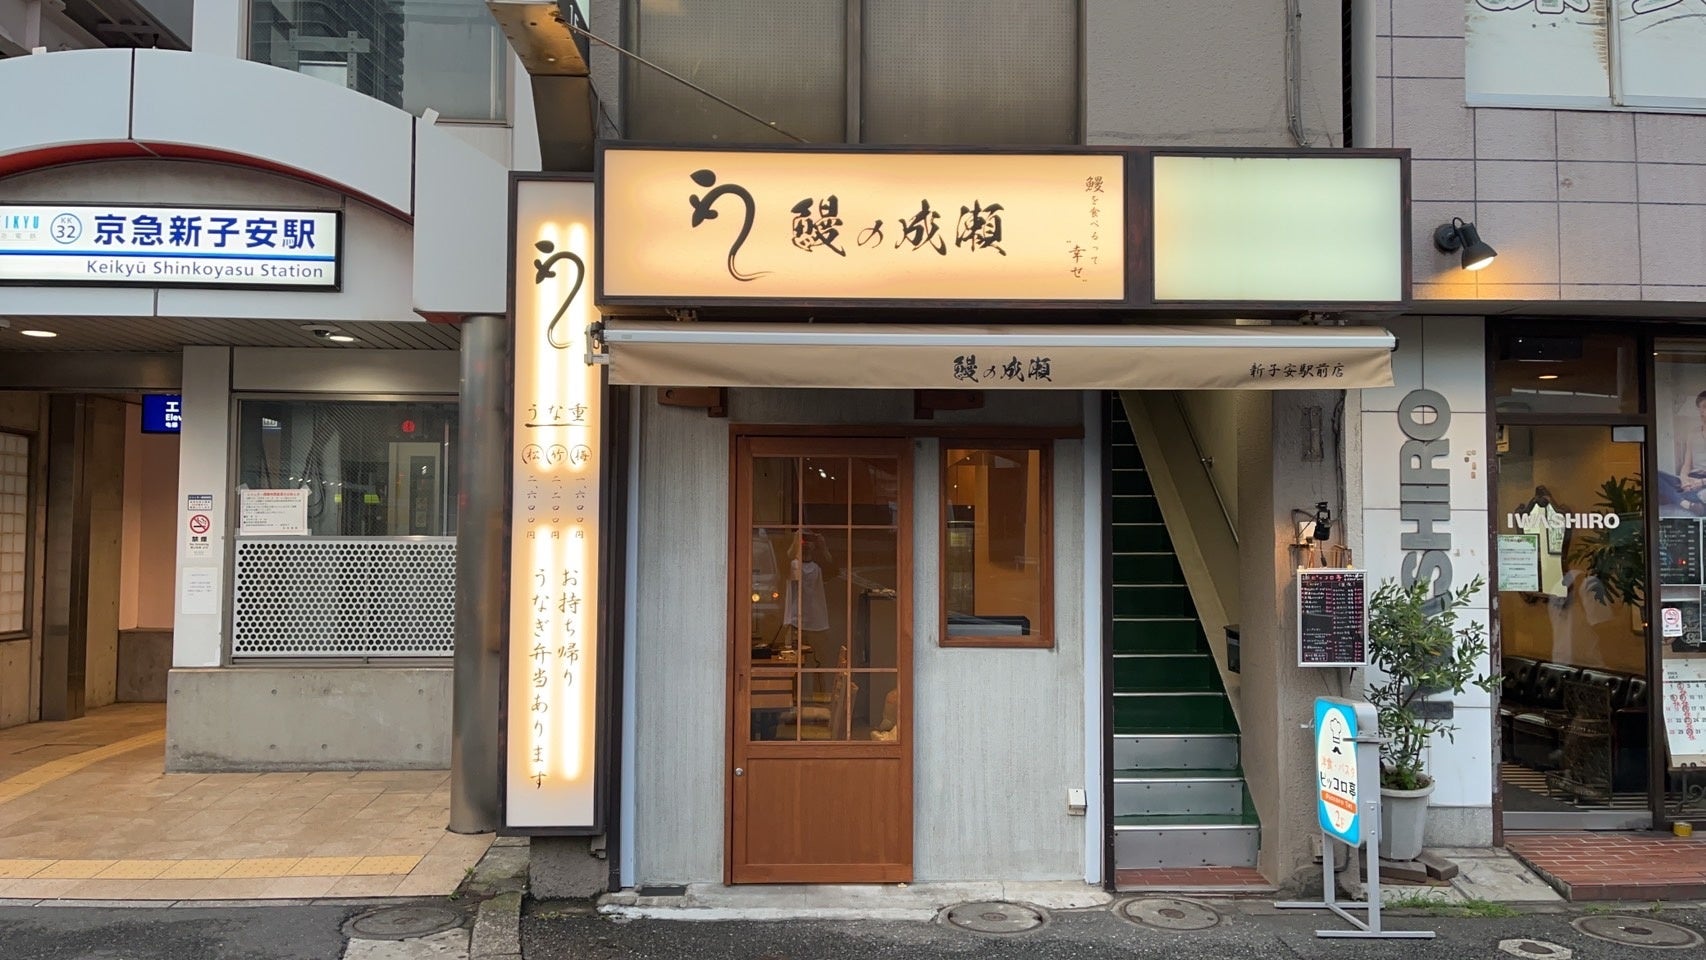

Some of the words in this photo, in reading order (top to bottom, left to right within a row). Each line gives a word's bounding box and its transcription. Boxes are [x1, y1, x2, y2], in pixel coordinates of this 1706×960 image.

[0, 215, 39, 229] IKYU
[56, 225, 76, 238] 32
[93, 213, 316, 249] 京急新子安駅
[790, 194, 1007, 258] 鰻の成瀬
[86, 260, 147, 276] Keikyū
[153, 261, 255, 279] Shinkoyasu
[260, 264, 323, 278] Station
[953, 354, 1052, 383] 鰻の成瀬
[1249, 362, 1345, 378] 新子安駅前店
[527, 403, 589, 421] うな重
[1507, 512, 1620, 529] IWASHIRO
[1397, 388, 1454, 720] ISHIRO
[557, 568, 582, 687] お持ち帰り
[528, 568, 552, 790] うなぎ弁当あります
